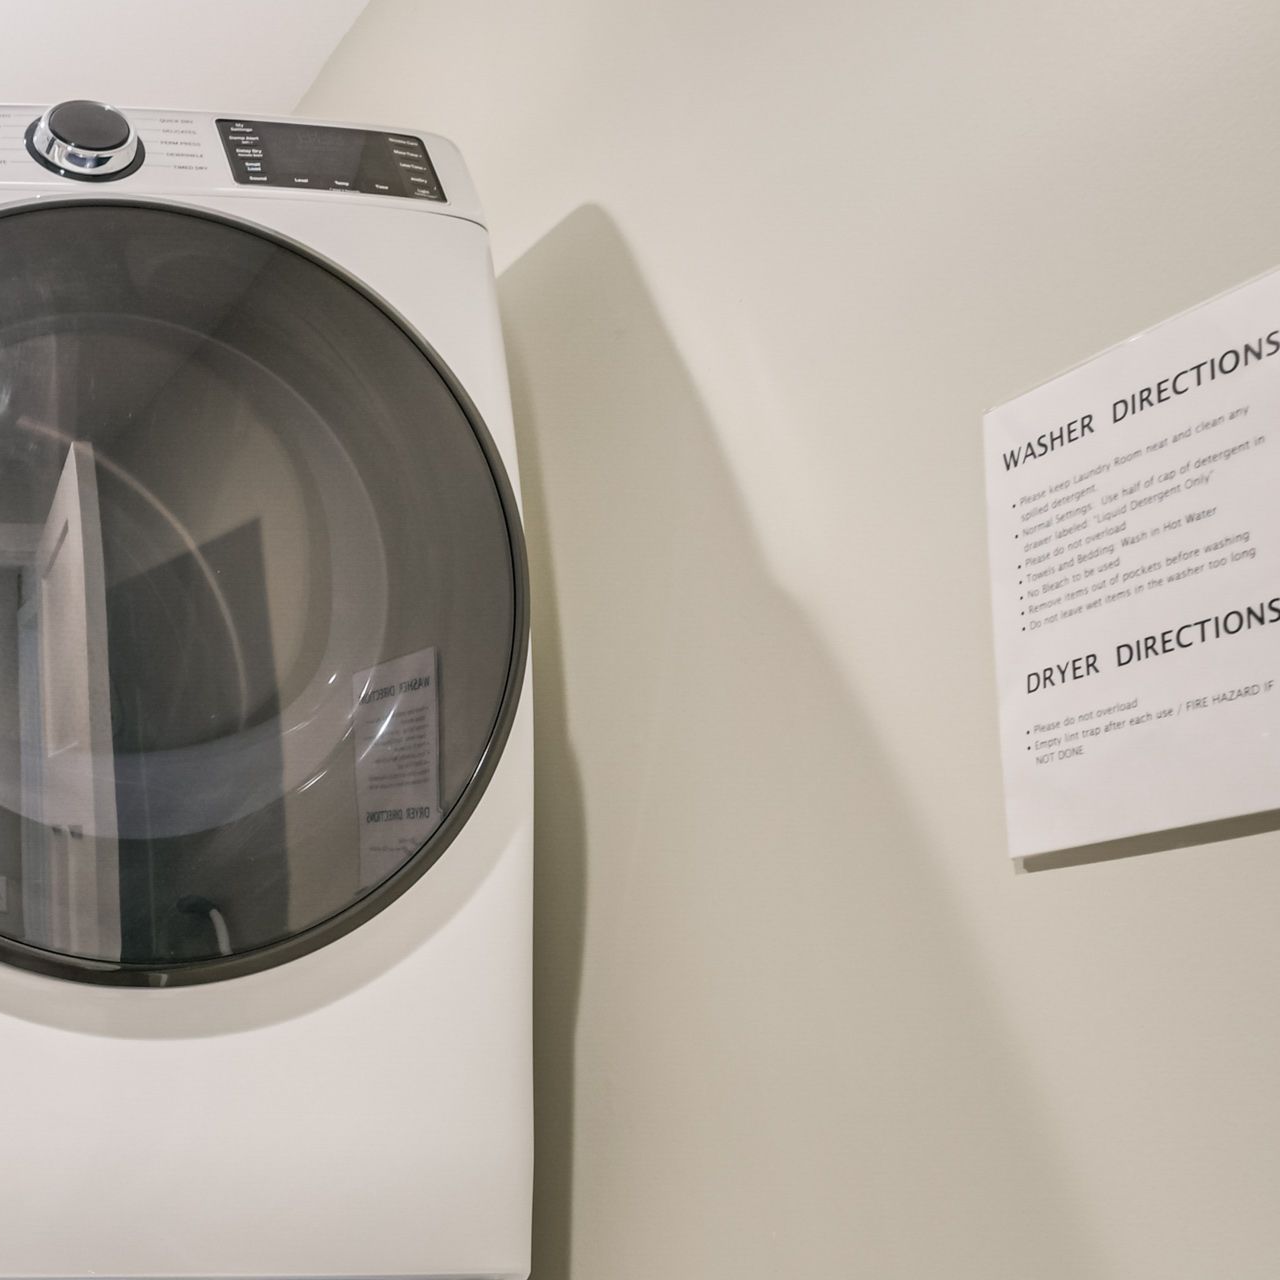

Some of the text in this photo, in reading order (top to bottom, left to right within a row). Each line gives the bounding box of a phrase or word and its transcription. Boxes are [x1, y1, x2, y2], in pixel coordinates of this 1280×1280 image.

[1002, 330, 1280, 472] WASHER DIRECTIONS
[1020, 405, 1250, 507] Please keep Laundry Room neat and clean any
[1022, 518, 1053, 536] Normal
[1101, 493, 1119, 507] Use
[1122, 481, 1141, 498] half
[1143, 475, 1155, 489] of
[1158, 468, 1177, 484] cap
[1179, 460, 1191, 474] of
[1194, 440, 1250, 469] detergent
[1254, 434, 1266, 447] in
[1021, 503, 1049, 522] spilled
[1023, 534, 1053, 553] drawer
[1130, 484, 1182, 512] Detergent
[1024, 520, 1128, 568] Please do not overload
[1026, 565, 1056, 583] Towels
[1058, 557, 1076, 572] and
[1121, 531, 1148, 548] Wash
[1151, 526, 1161, 538] in
[1163, 518, 1183, 532] Hot
[1185, 506, 1218, 524] Water
[1027, 556, 1122, 599] No Bleach to be used
[1028, 530, 1251, 614] Remove items out of pockets before washing
[1029, 545, 1258, 631] Do not leave wet items in the washer too long
[1025, 597, 1280, 695] DRYER DIRECTIONS
[1033, 697, 1139, 734] Please do not overload
[1034, 736, 1062, 752] Empty
[1064, 731, 1080, 743] lint
[1081, 726, 1102, 739] trap
[1104, 718, 1127, 734] after
[1129, 711, 1154, 726] each
[1156, 707, 1175, 720] use
[1185, 696, 1210, 712] FIRE
[1211, 683, 1262, 705] HAZARD
[1264, 679, 1276, 693] IF
[1035, 744, 1085, 765] NOT DONE
